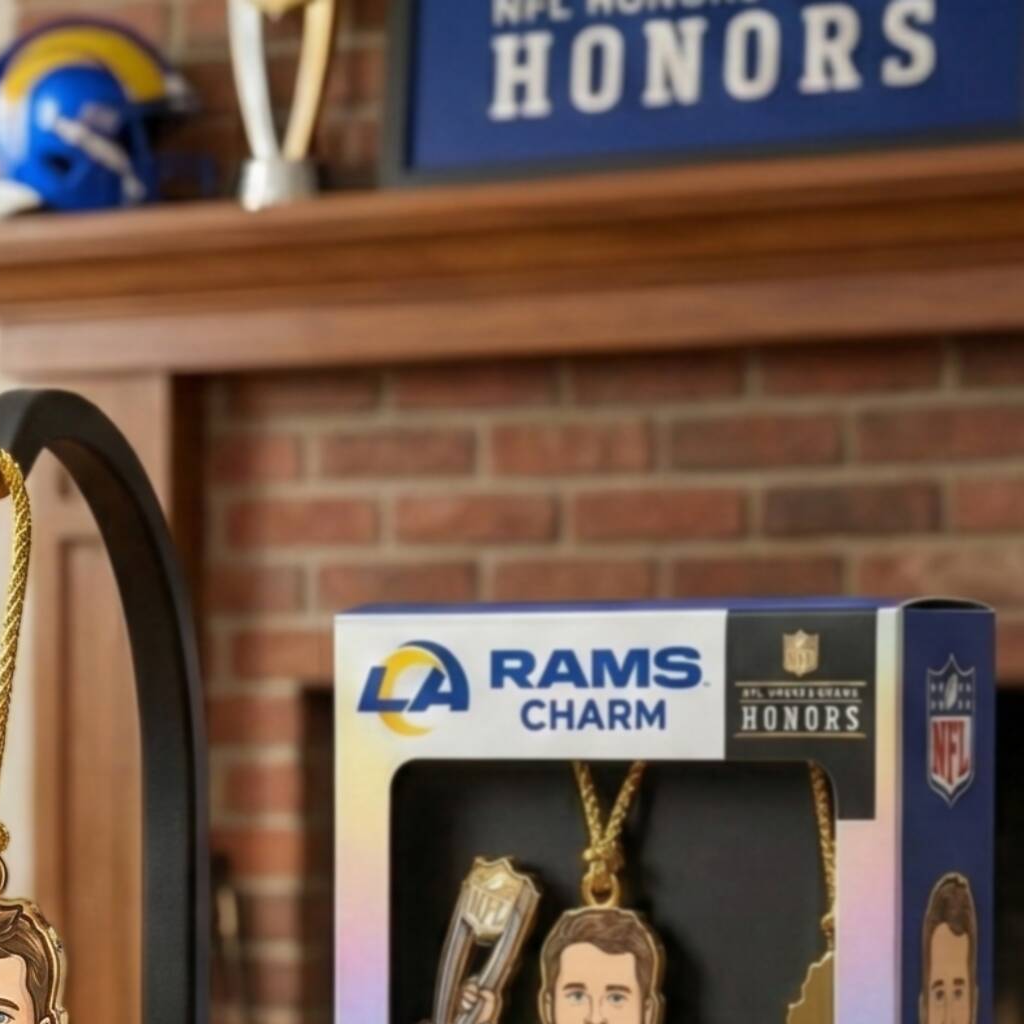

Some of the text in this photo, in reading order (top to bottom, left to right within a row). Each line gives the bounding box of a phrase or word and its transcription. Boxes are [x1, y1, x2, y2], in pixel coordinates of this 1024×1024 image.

[488, 0, 936, 120] HONORS
[489, 646, 702, 689] RAMS
[520, 698, 666, 731] CHARM
[742, 705, 860, 731] HONORS
[932, 719, 971, 786] NFL
